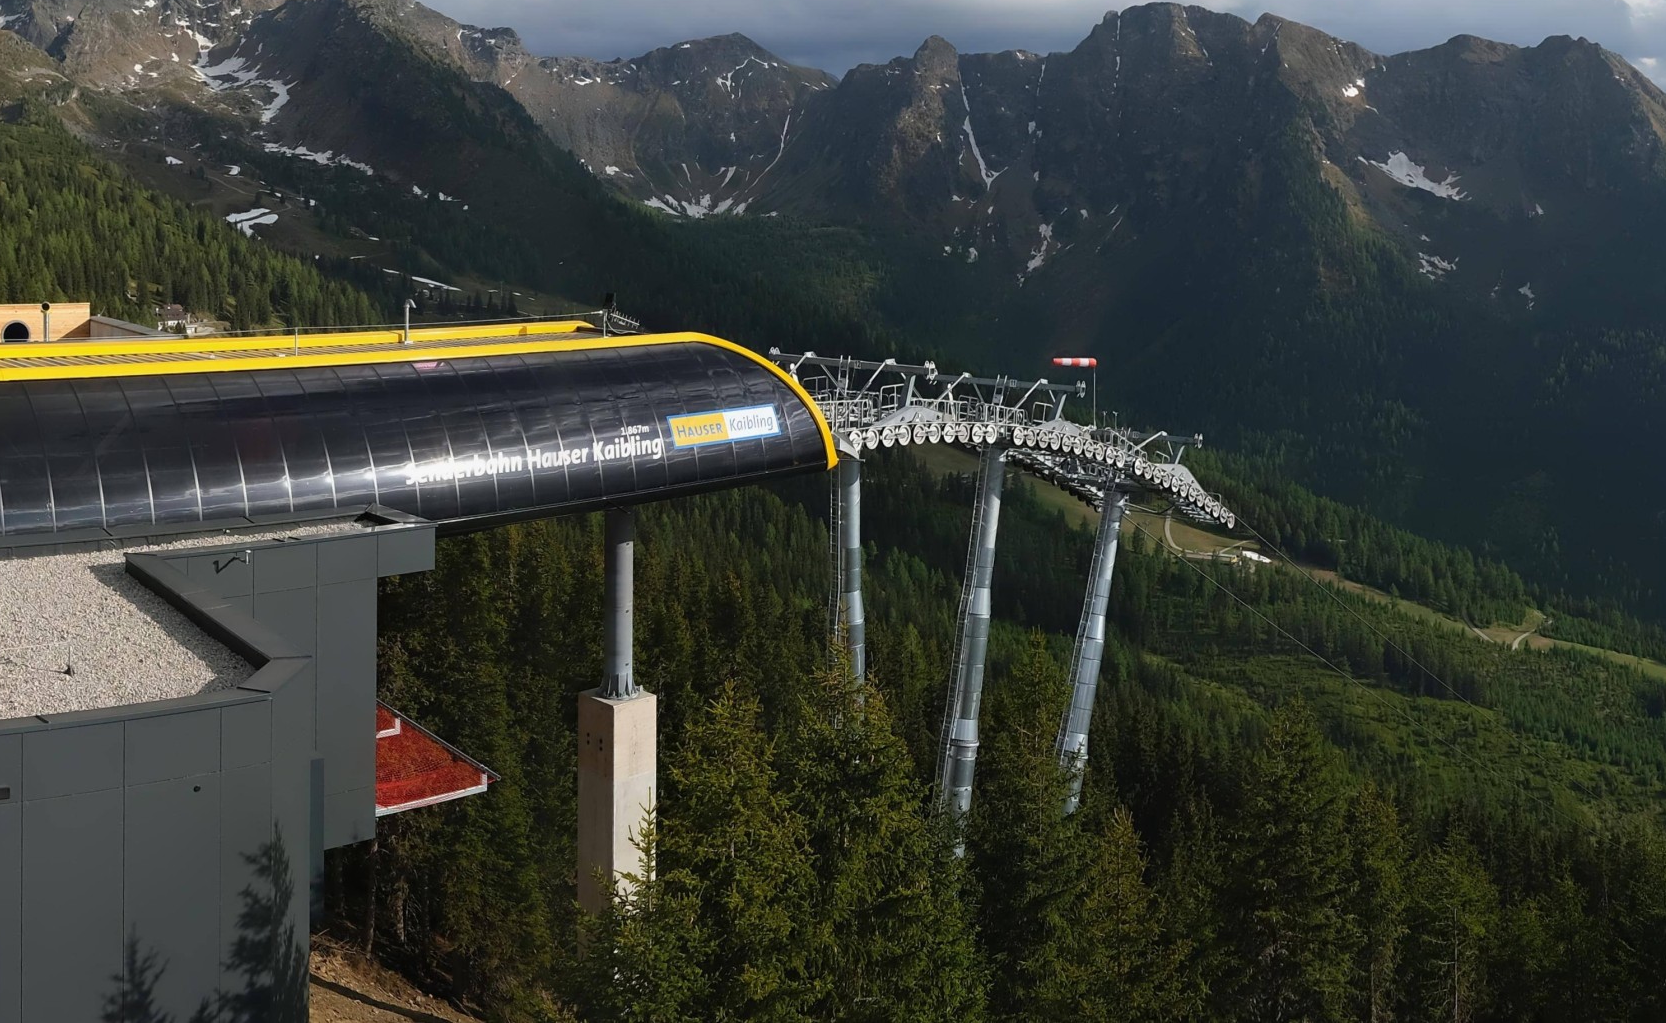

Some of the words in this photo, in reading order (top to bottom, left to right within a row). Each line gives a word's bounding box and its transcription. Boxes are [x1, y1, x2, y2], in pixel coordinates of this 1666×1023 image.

[676, 422, 724, 438] HAUSER
[729, 414, 774, 432] Kaibling
[527, 446, 589, 470] Hauser
[593, 434, 662, 461] Kaibling
